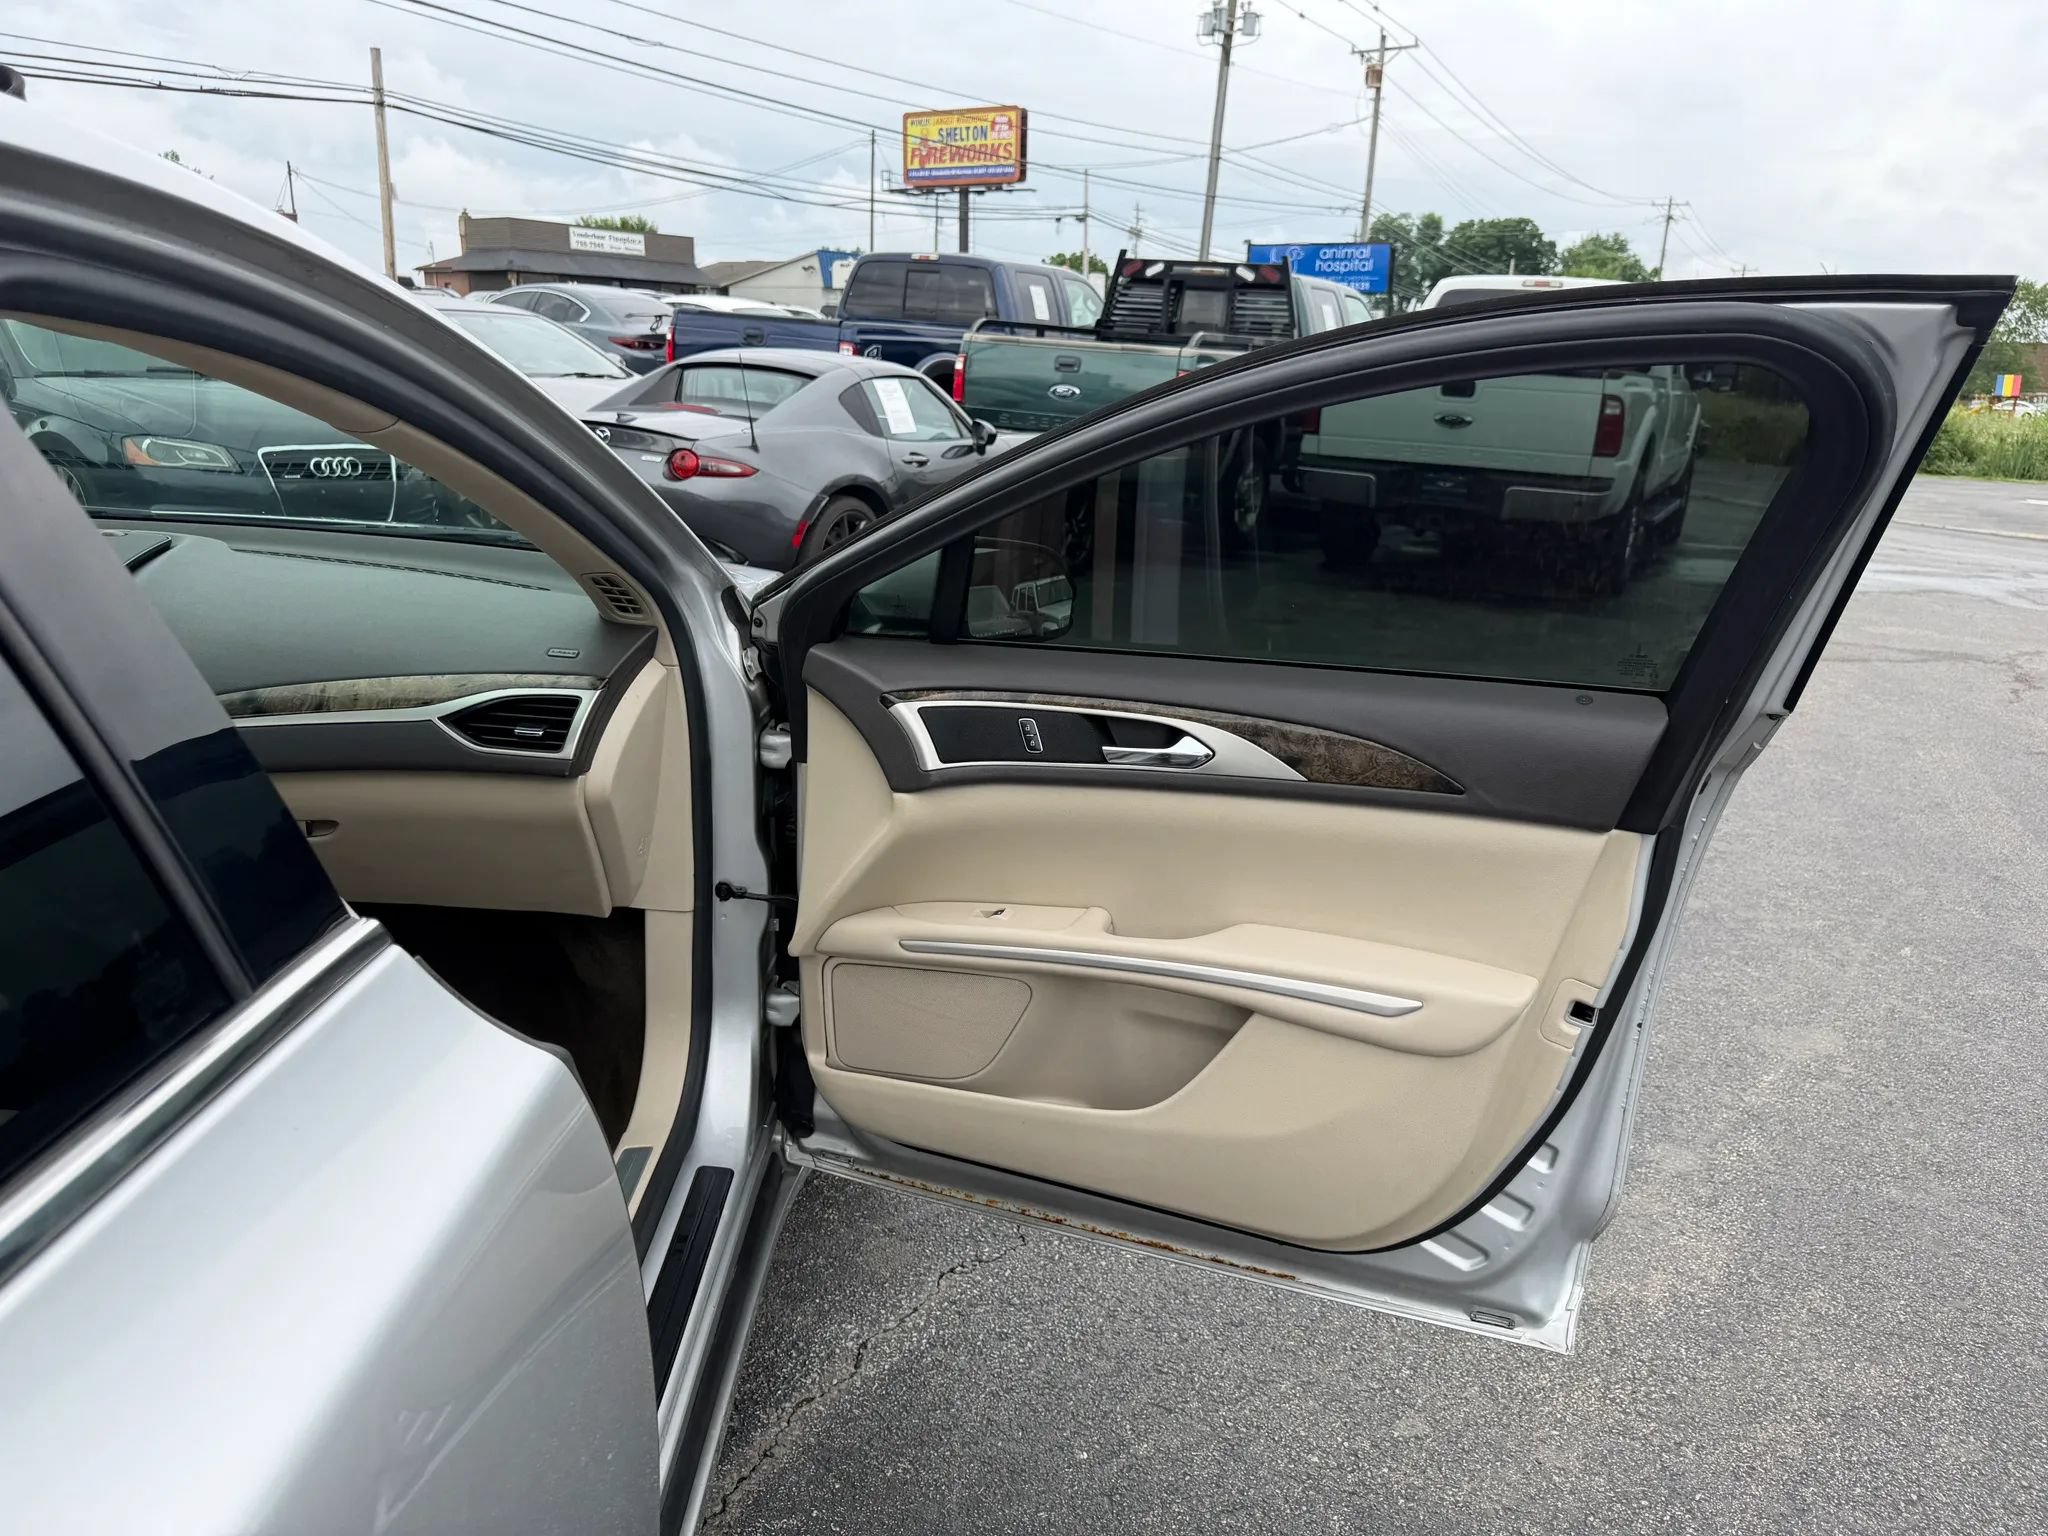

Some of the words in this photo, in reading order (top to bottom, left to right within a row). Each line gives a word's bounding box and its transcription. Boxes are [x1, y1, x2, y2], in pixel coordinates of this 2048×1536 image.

[938, 126, 988, 143] SHELTON
[911, 142, 1013, 166] FIREWORKS
[1319, 245, 1372, 260] animal
[1315, 258, 1374, 274] hospital
